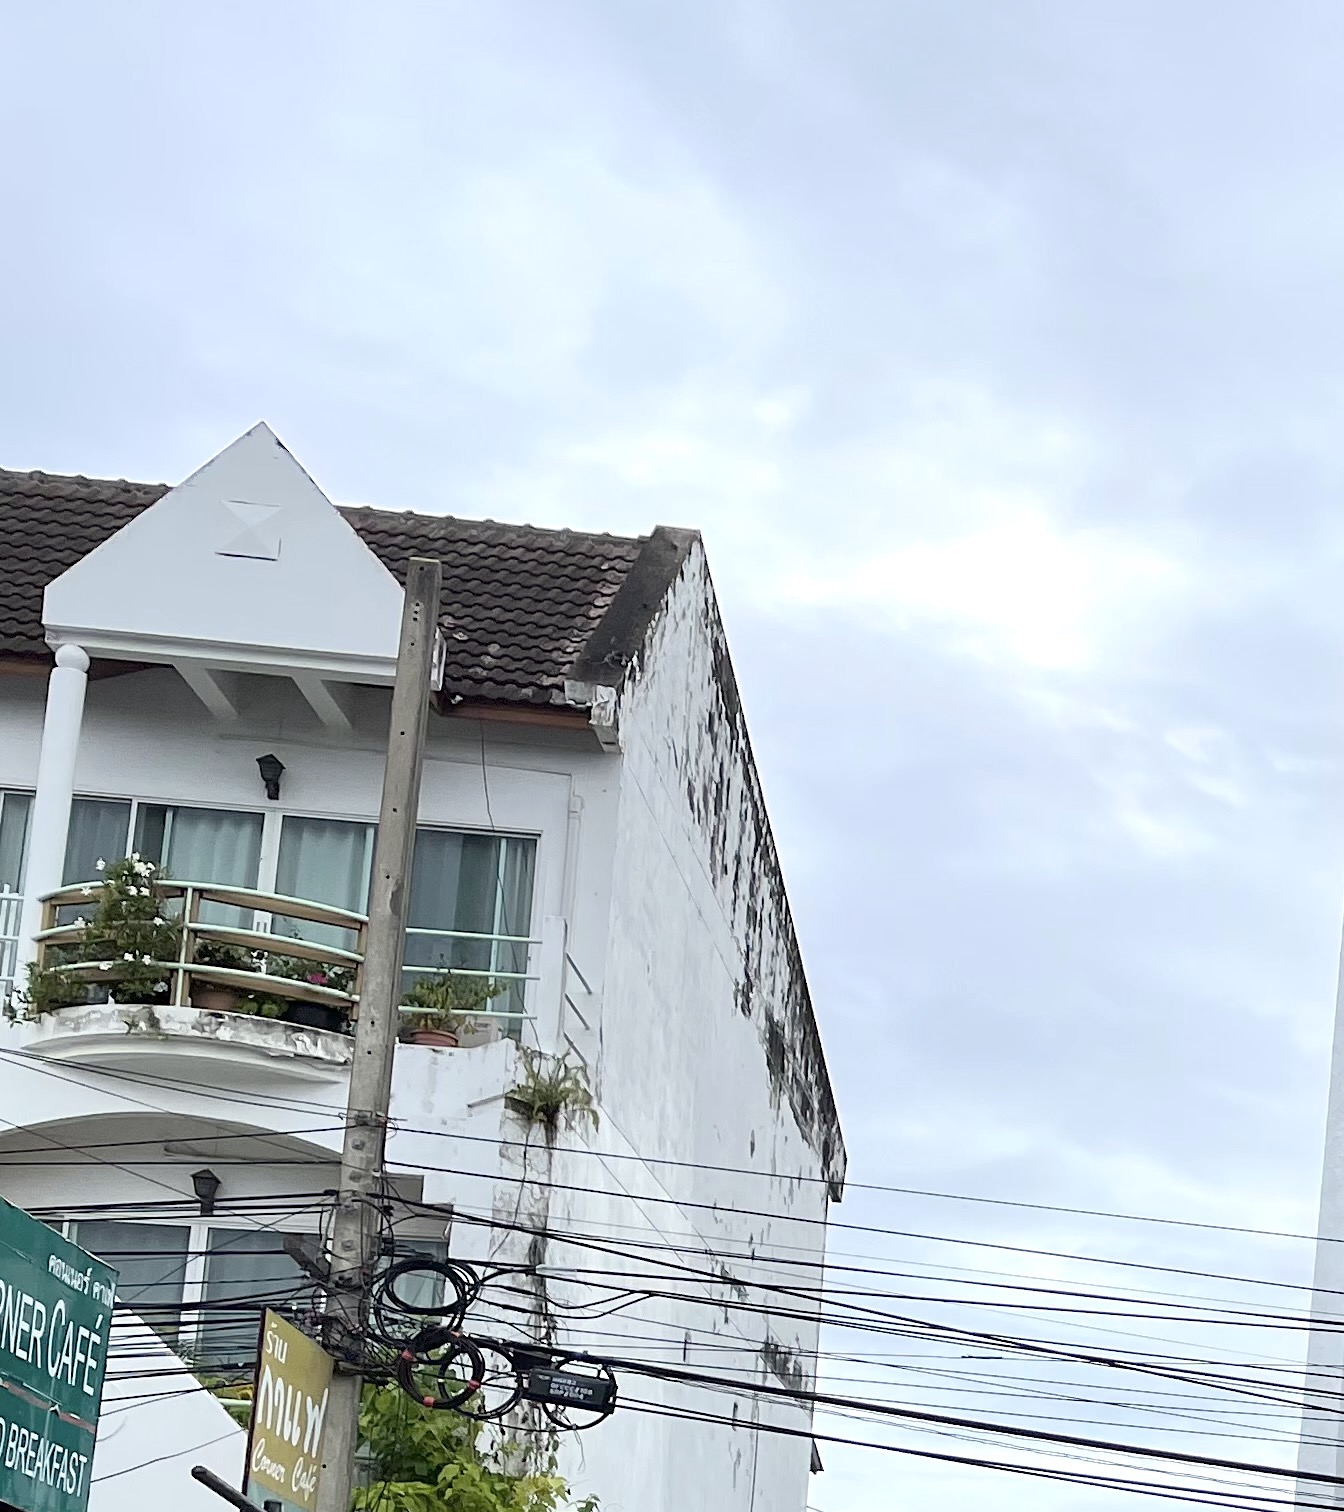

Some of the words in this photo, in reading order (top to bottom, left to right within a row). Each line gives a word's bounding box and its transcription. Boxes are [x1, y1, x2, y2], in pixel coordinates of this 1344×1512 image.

[0, 1279, 46, 1369] NER
[48, 1299, 102, 1396] CAFÉ
[265, 1321, 288, 1364] ร้าน
[256, 1364, 329, 1458] กาแฟ
[5, 1424, 87, 1497] BREAKFAST
[252, 1437, 286, 1484] Corner
